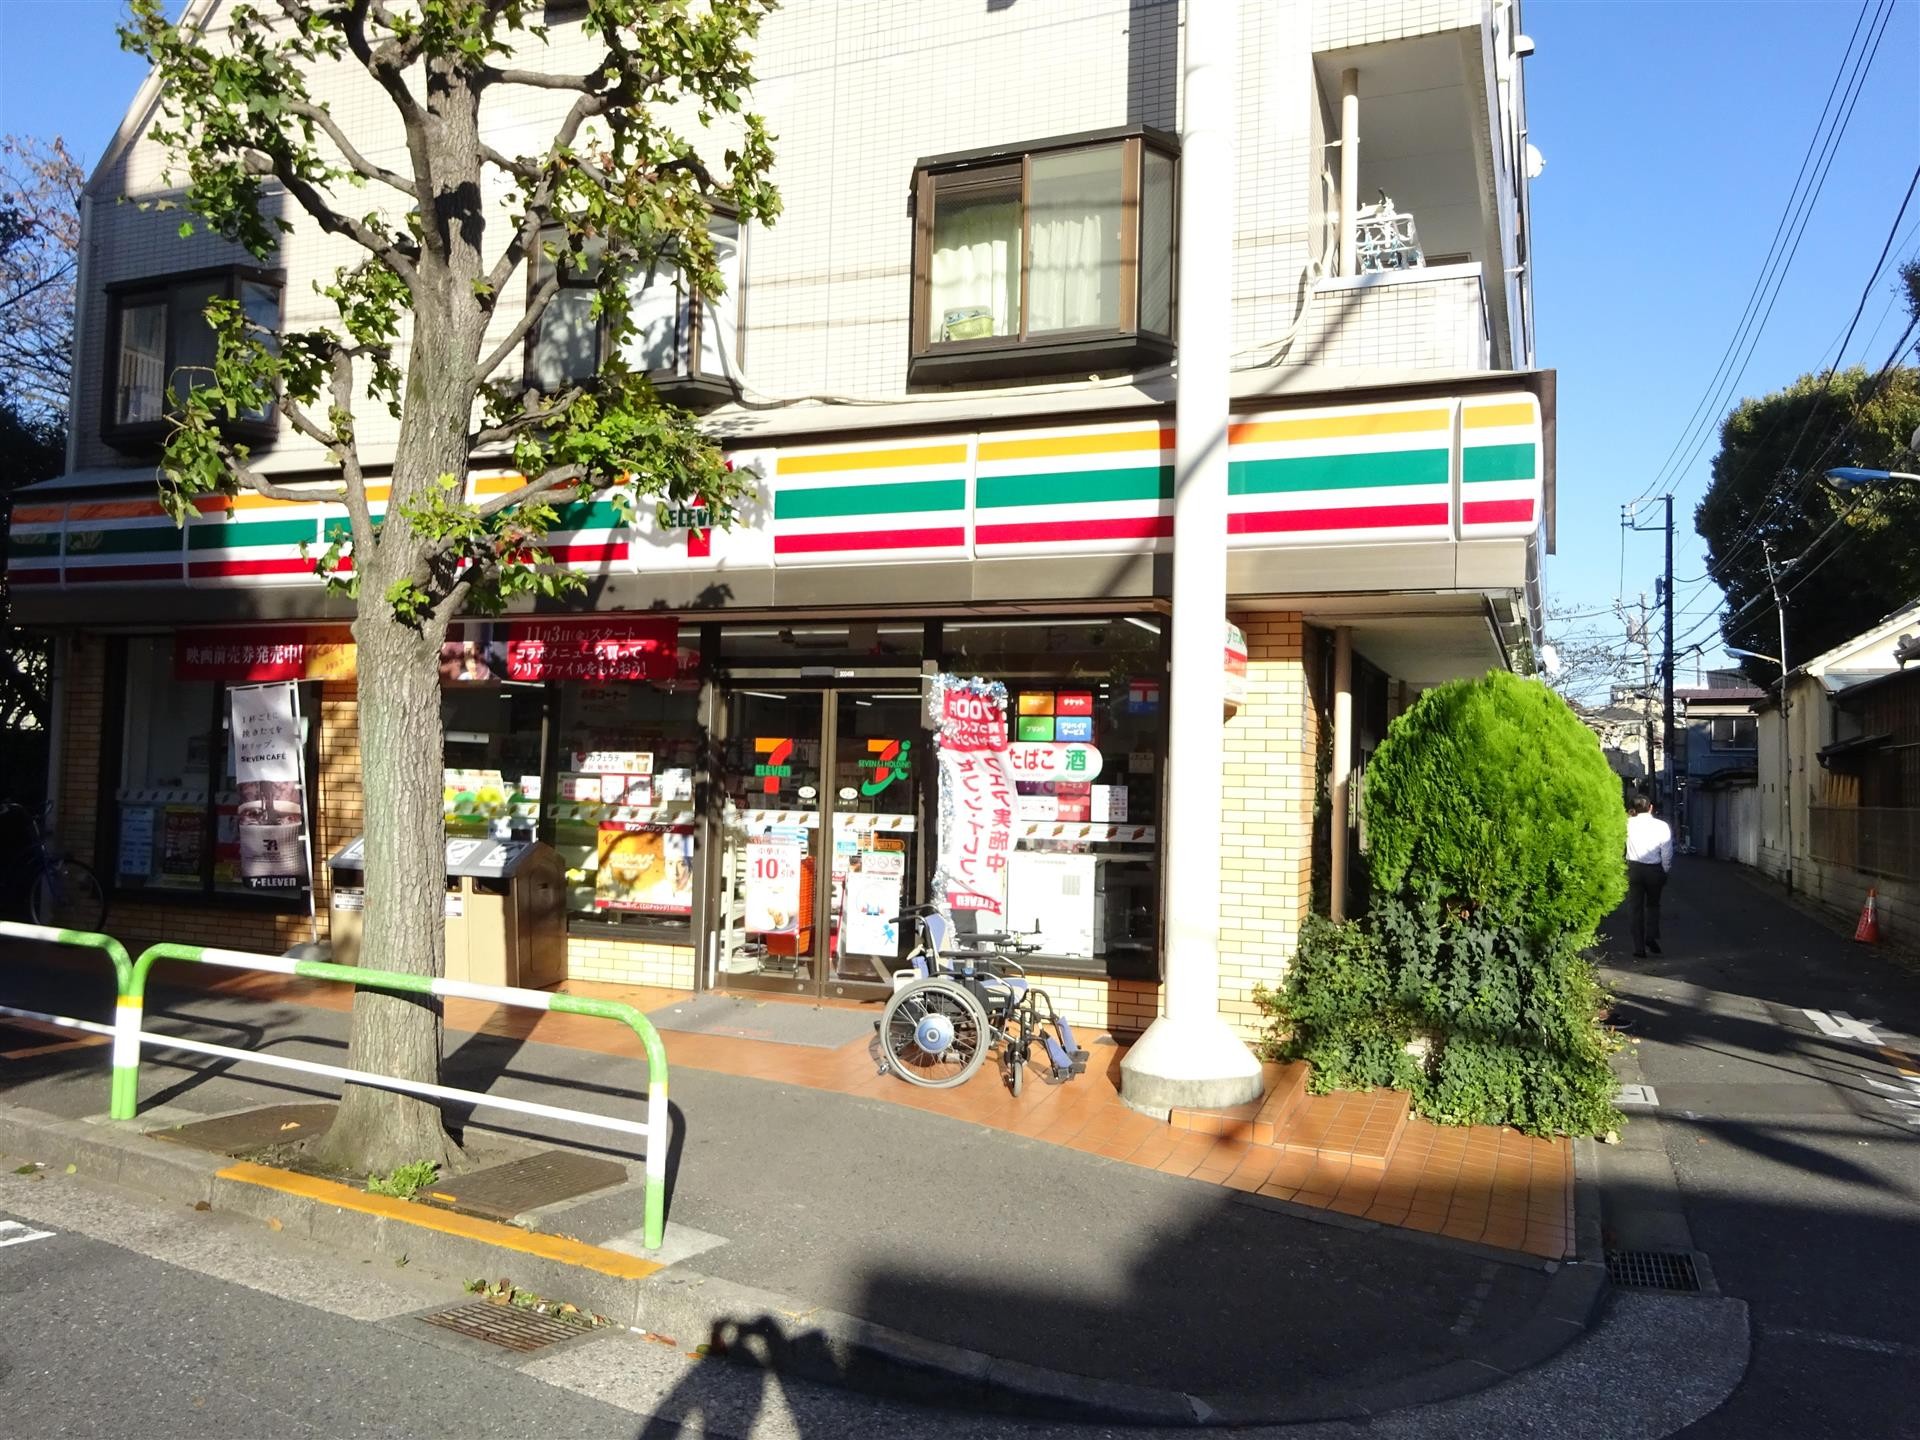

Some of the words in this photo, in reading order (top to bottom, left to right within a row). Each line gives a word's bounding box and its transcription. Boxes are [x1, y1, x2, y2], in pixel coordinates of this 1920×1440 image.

[1009, 748, 1055, 770] たばこ
[1066, 748, 1087, 772] 酒
[755, 858, 778, 879] 10
